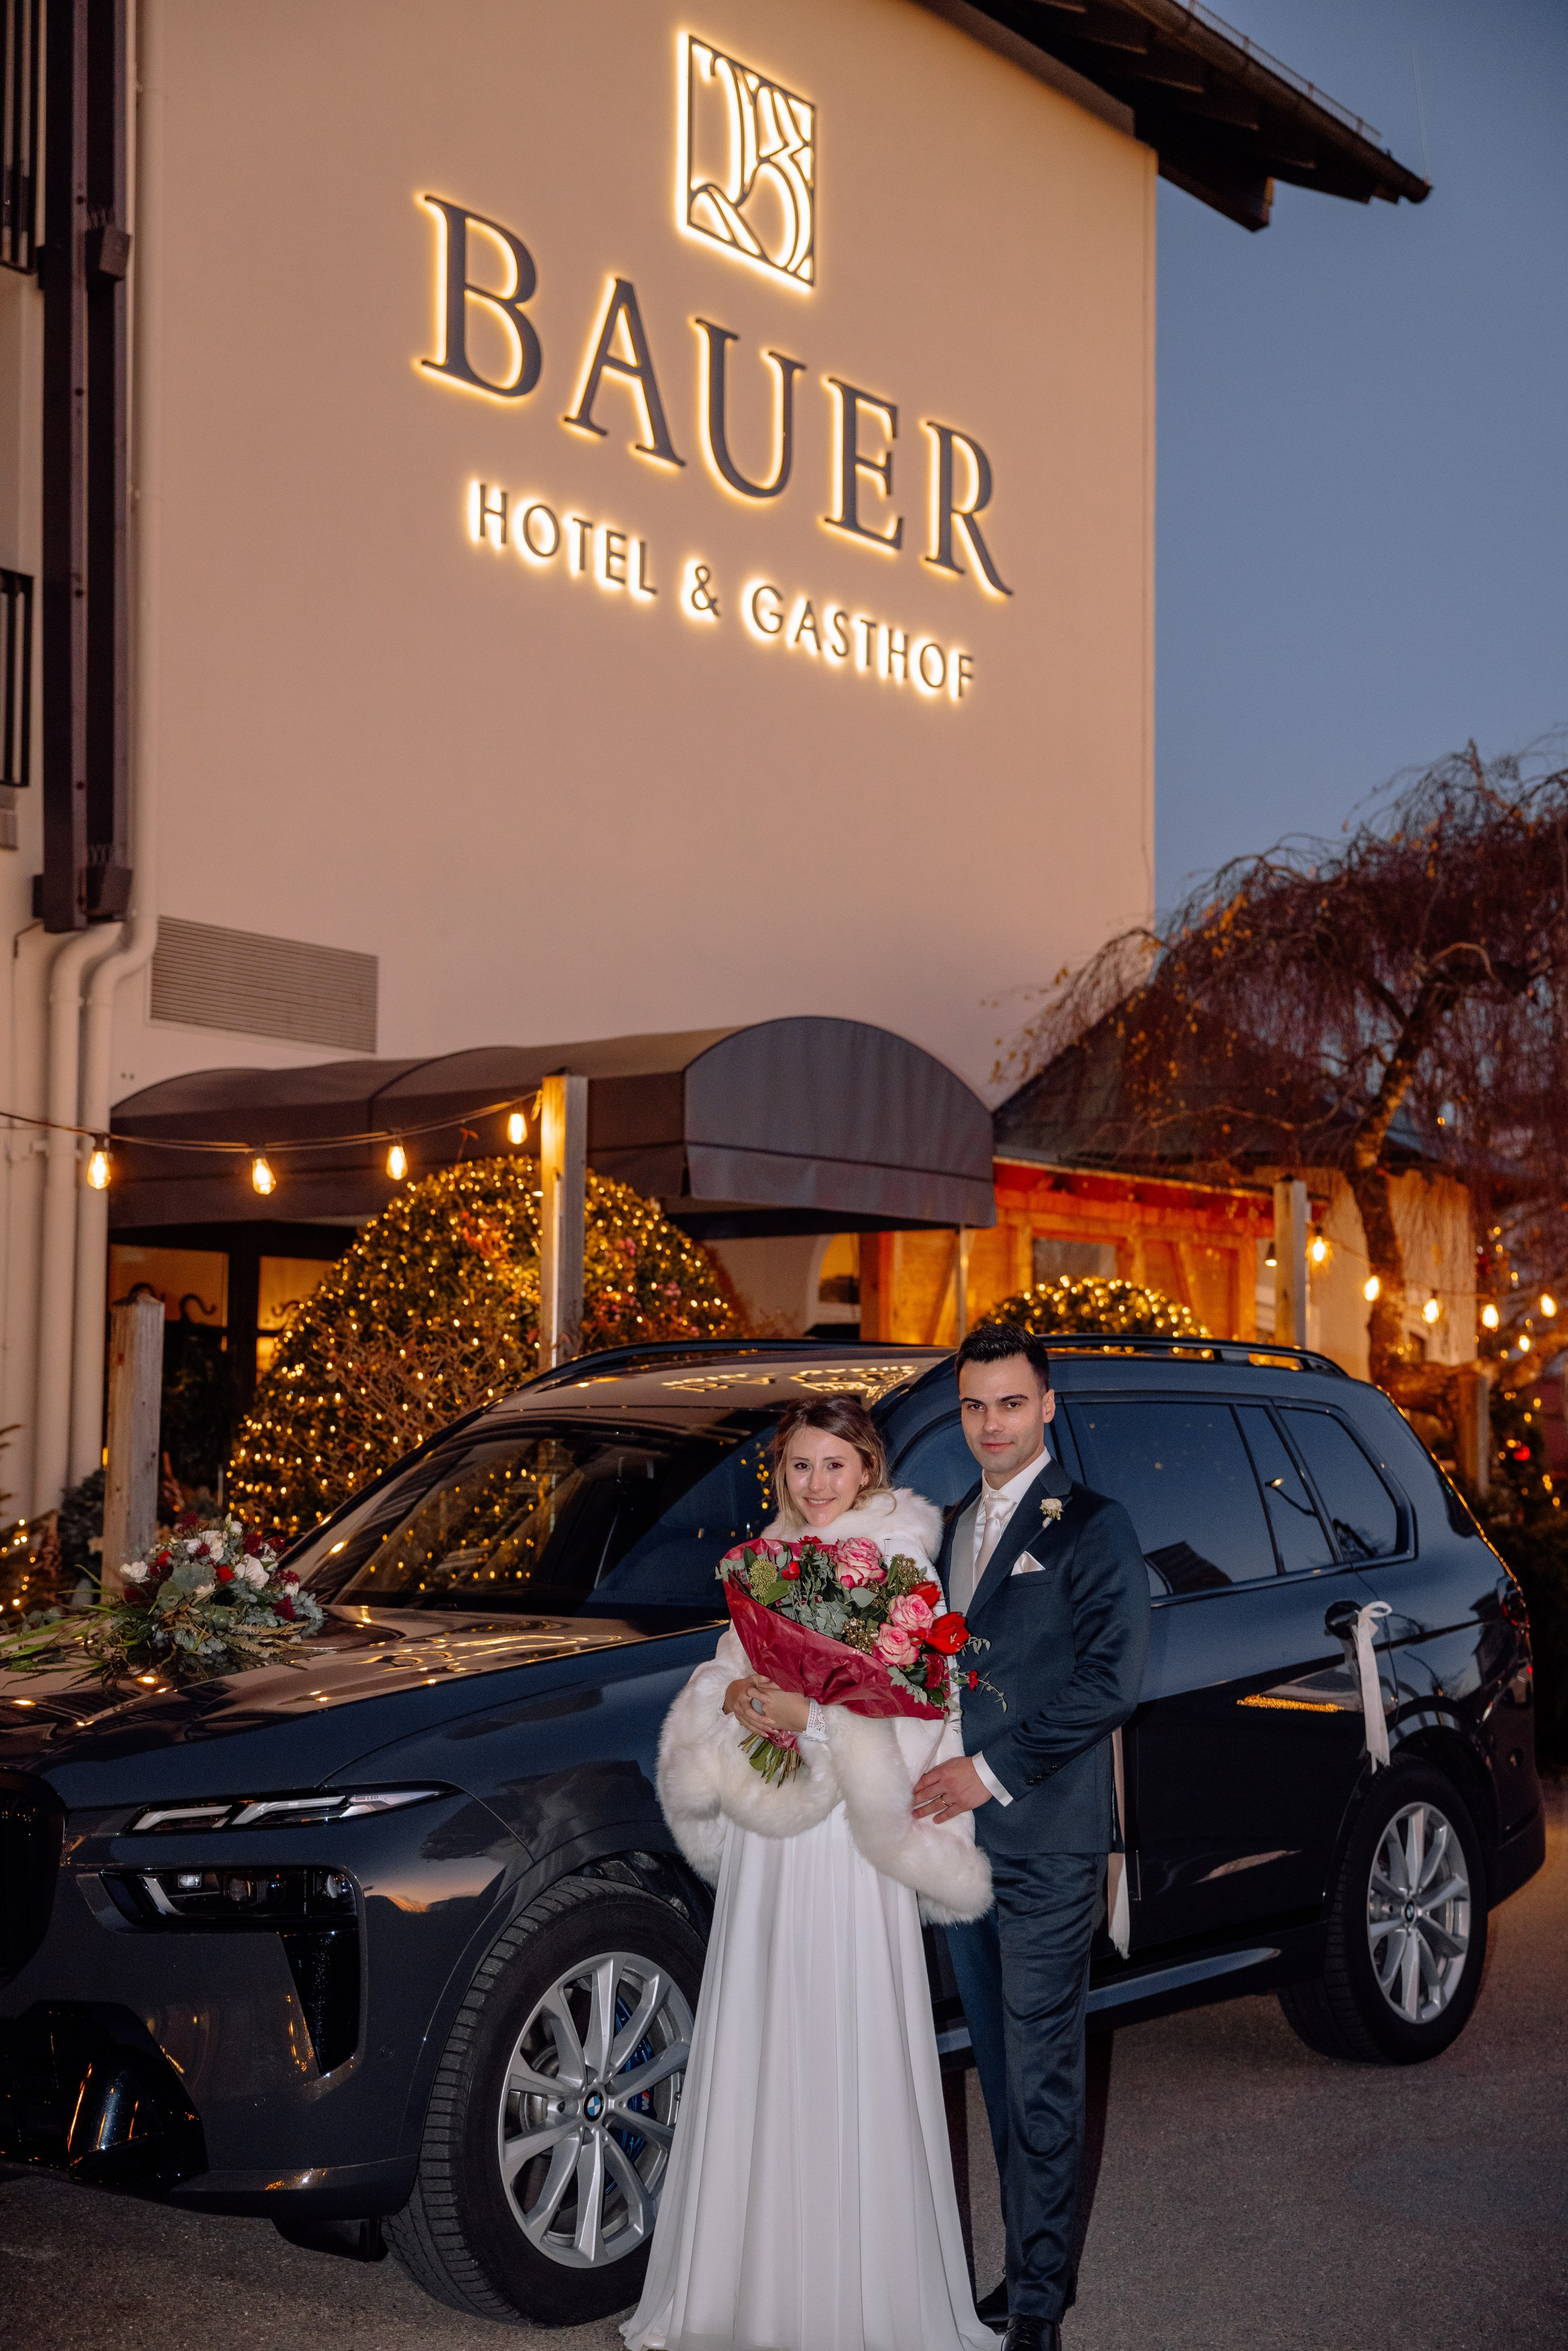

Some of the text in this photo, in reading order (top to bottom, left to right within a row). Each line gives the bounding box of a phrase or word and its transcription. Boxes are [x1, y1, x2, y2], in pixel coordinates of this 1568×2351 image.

[421, 194, 1014, 596] BAUER
[478, 484, 974, 698] HOTEL & GASTHOF
